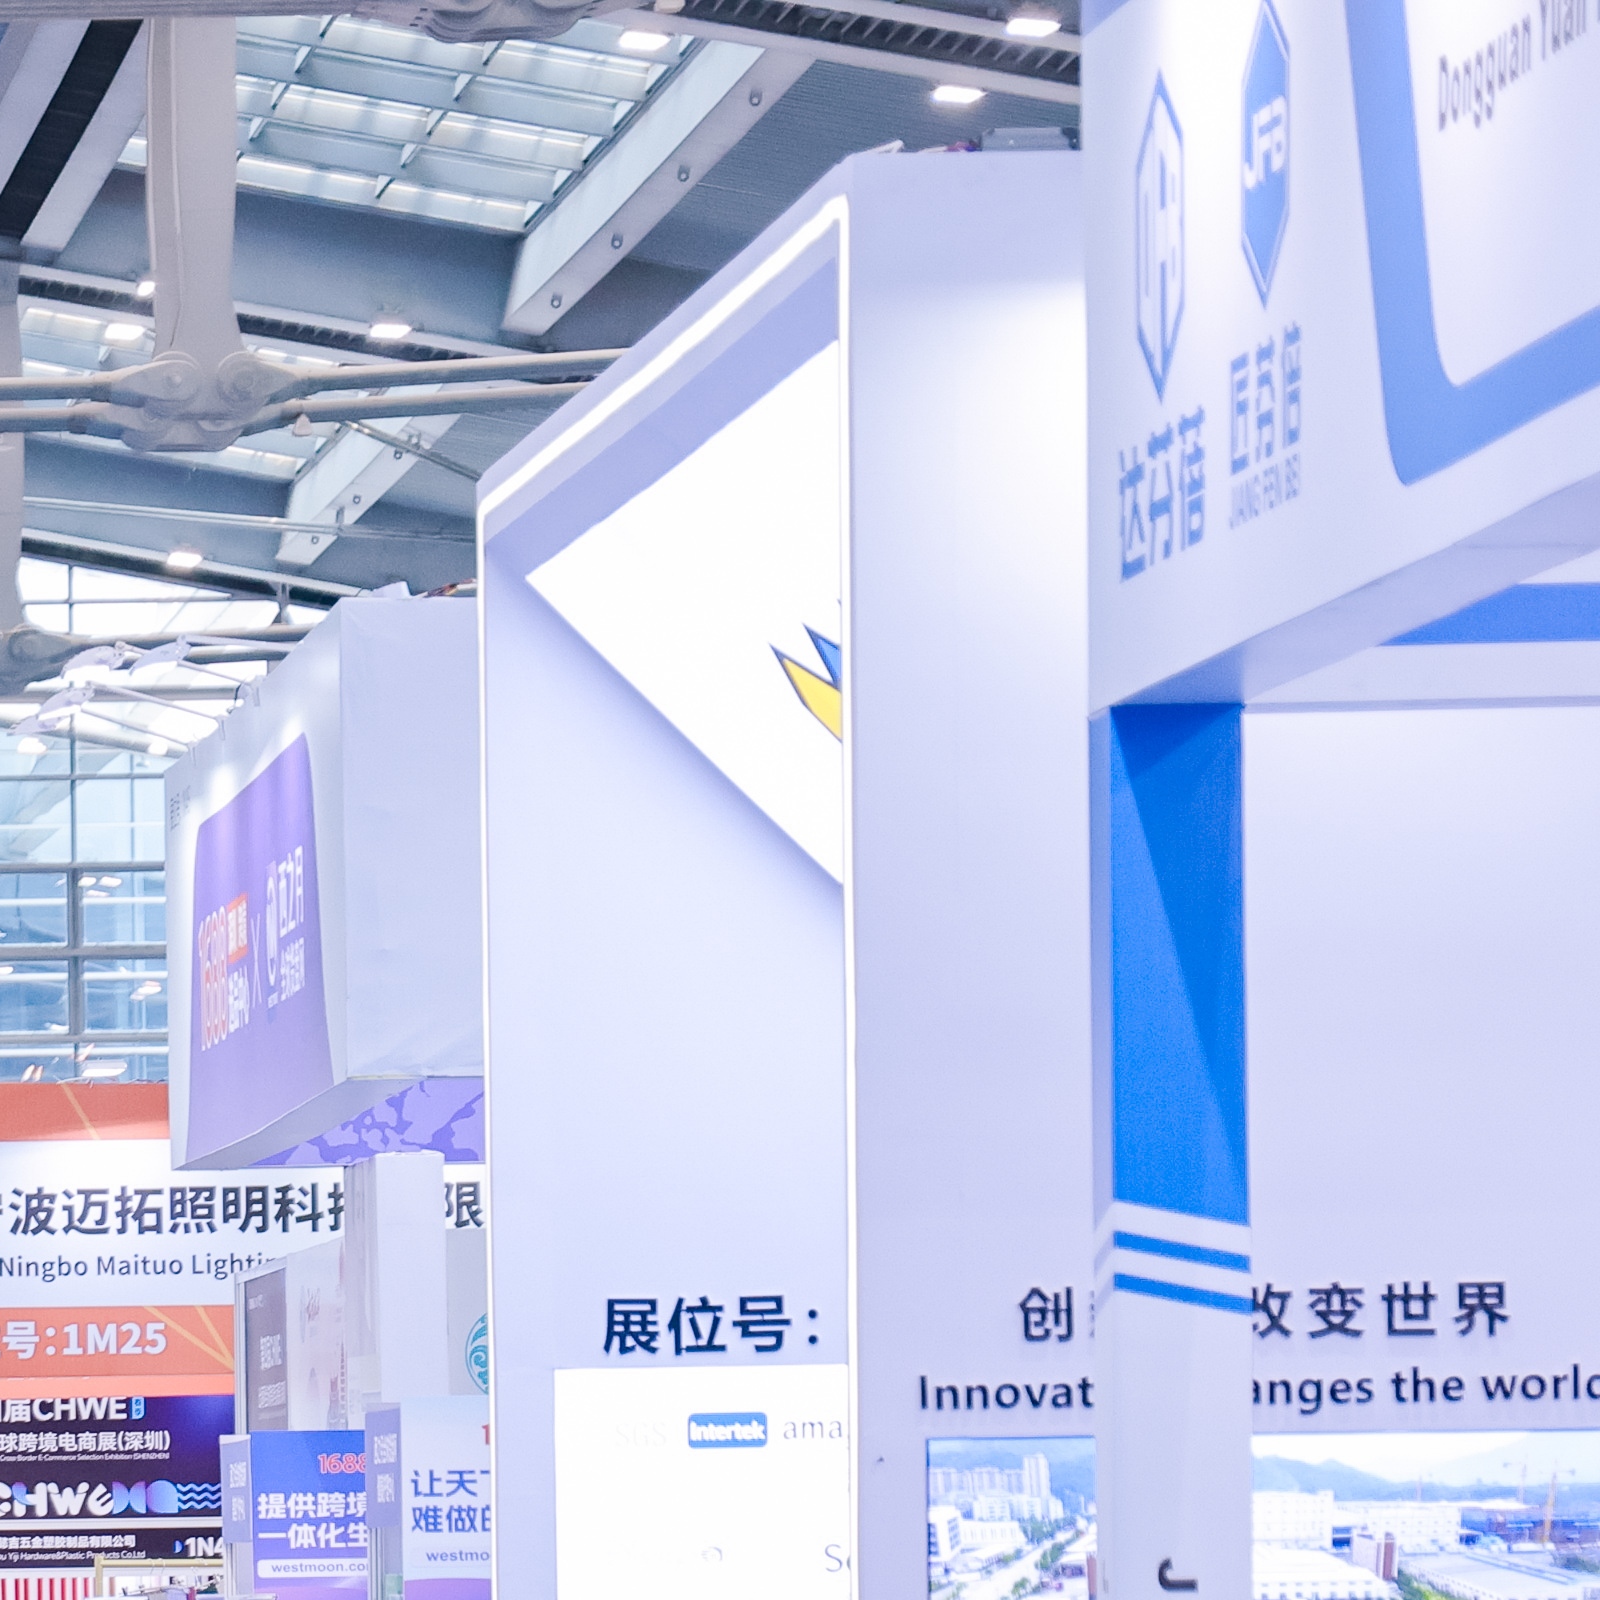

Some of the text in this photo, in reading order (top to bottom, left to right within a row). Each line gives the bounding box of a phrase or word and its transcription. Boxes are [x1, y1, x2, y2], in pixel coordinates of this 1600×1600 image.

[1438, 14, 1531, 133] Dongguan
[0, 1252, 276, 1282] Ningbo Maituo Lighti
[603, 1294, 819, 1355] 展位号:
[919, 1374, 1094, 1411] Innovat
[1251, 1373, 1374, 1413] anges
[1392, 1367, 1464, 1403] the
[690, 1420, 766, 1444] Intertek
[783, 1419, 848, 1442] ama
[86, 1550, 119, 1560] Prducts
[426, 1550, 491, 1562] westmo
